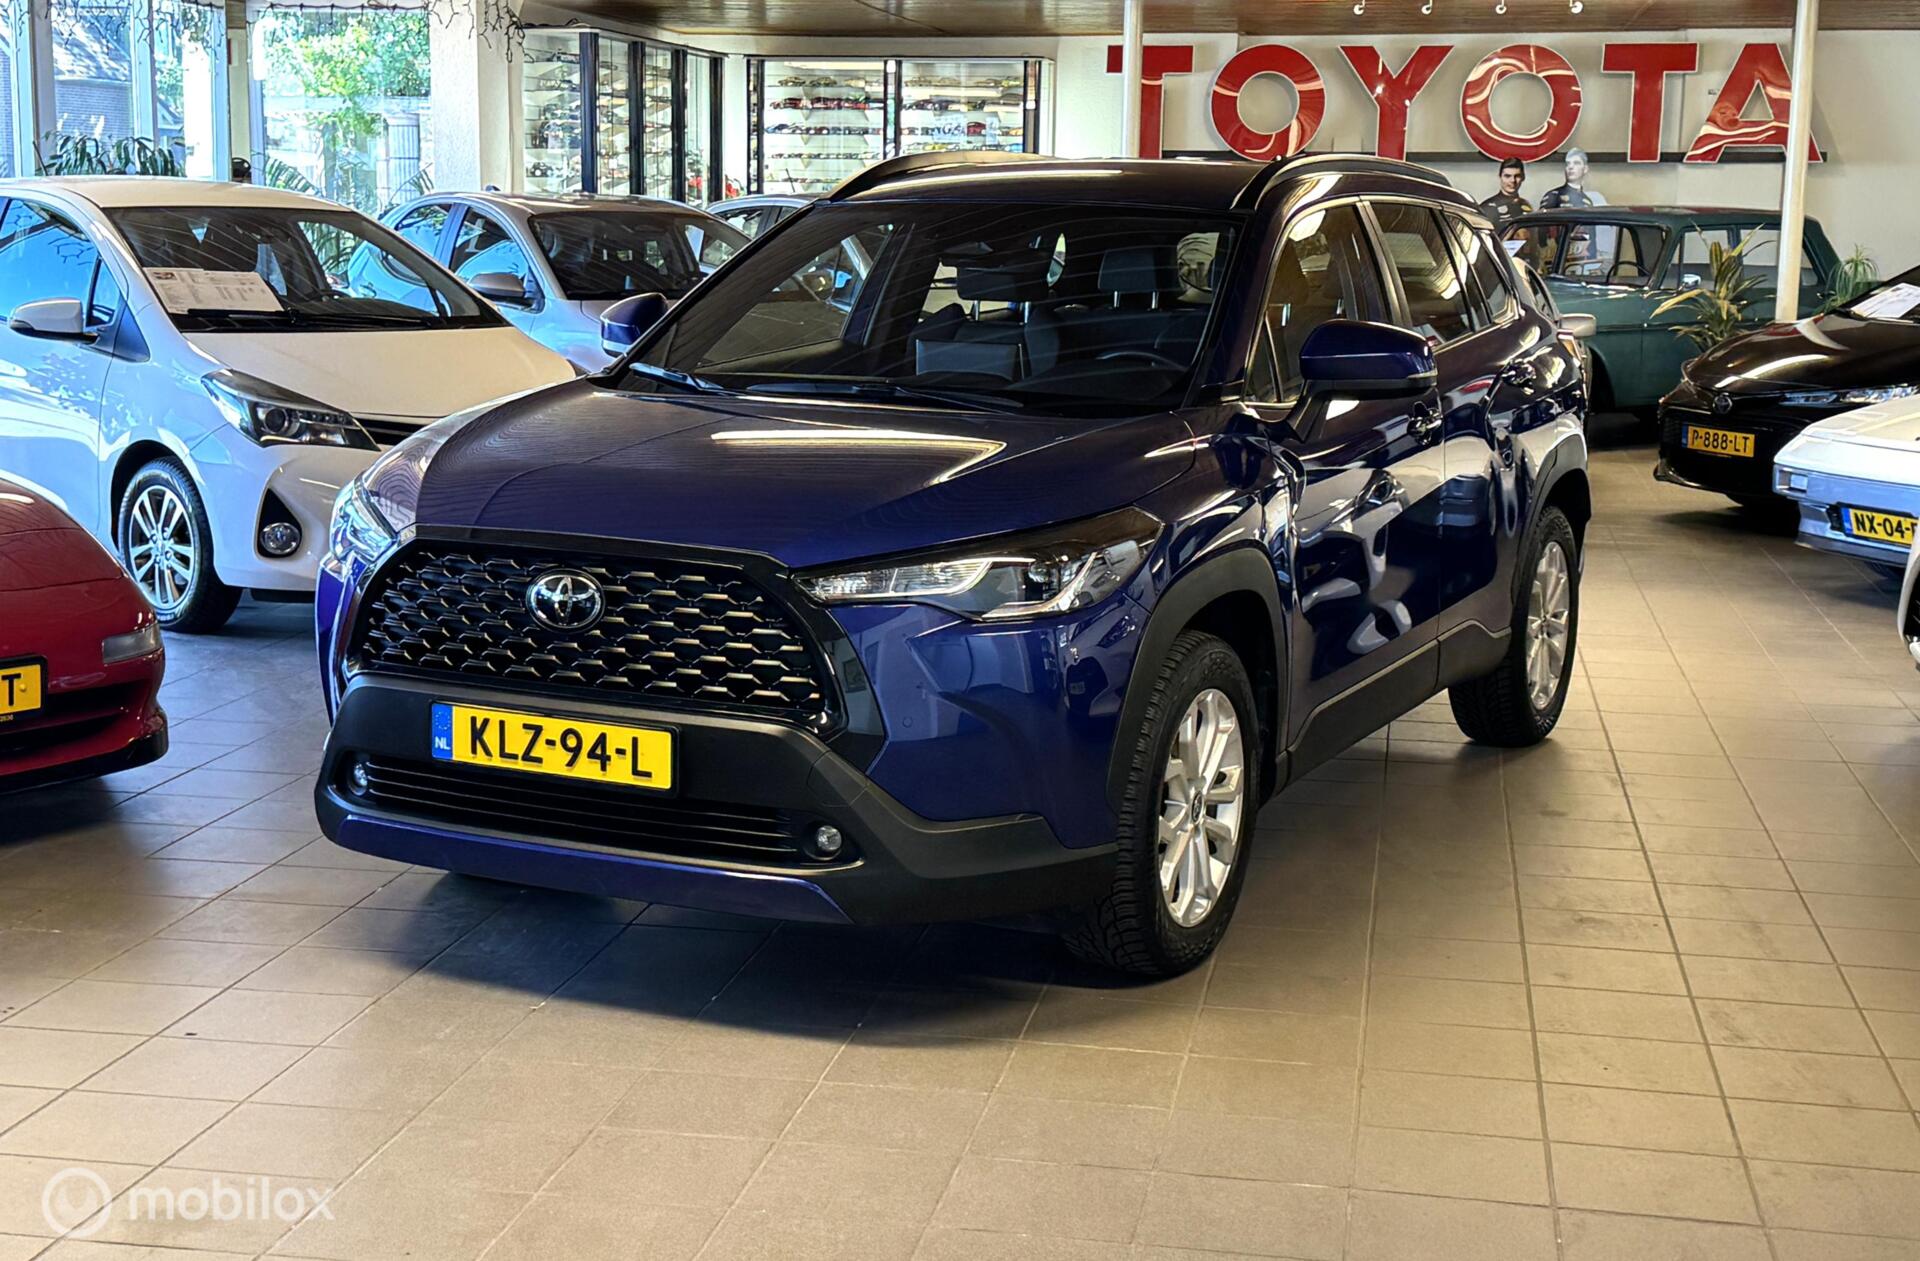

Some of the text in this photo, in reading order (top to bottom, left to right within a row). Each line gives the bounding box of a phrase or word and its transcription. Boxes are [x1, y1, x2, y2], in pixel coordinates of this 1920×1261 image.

[1106, 42, 1823, 163] TOYOTA
[1692, 429, 1750, 453] P-888-LT
[434, 736, 450, 750] NL
[470, 715, 653, 779] KLZ-94-L
